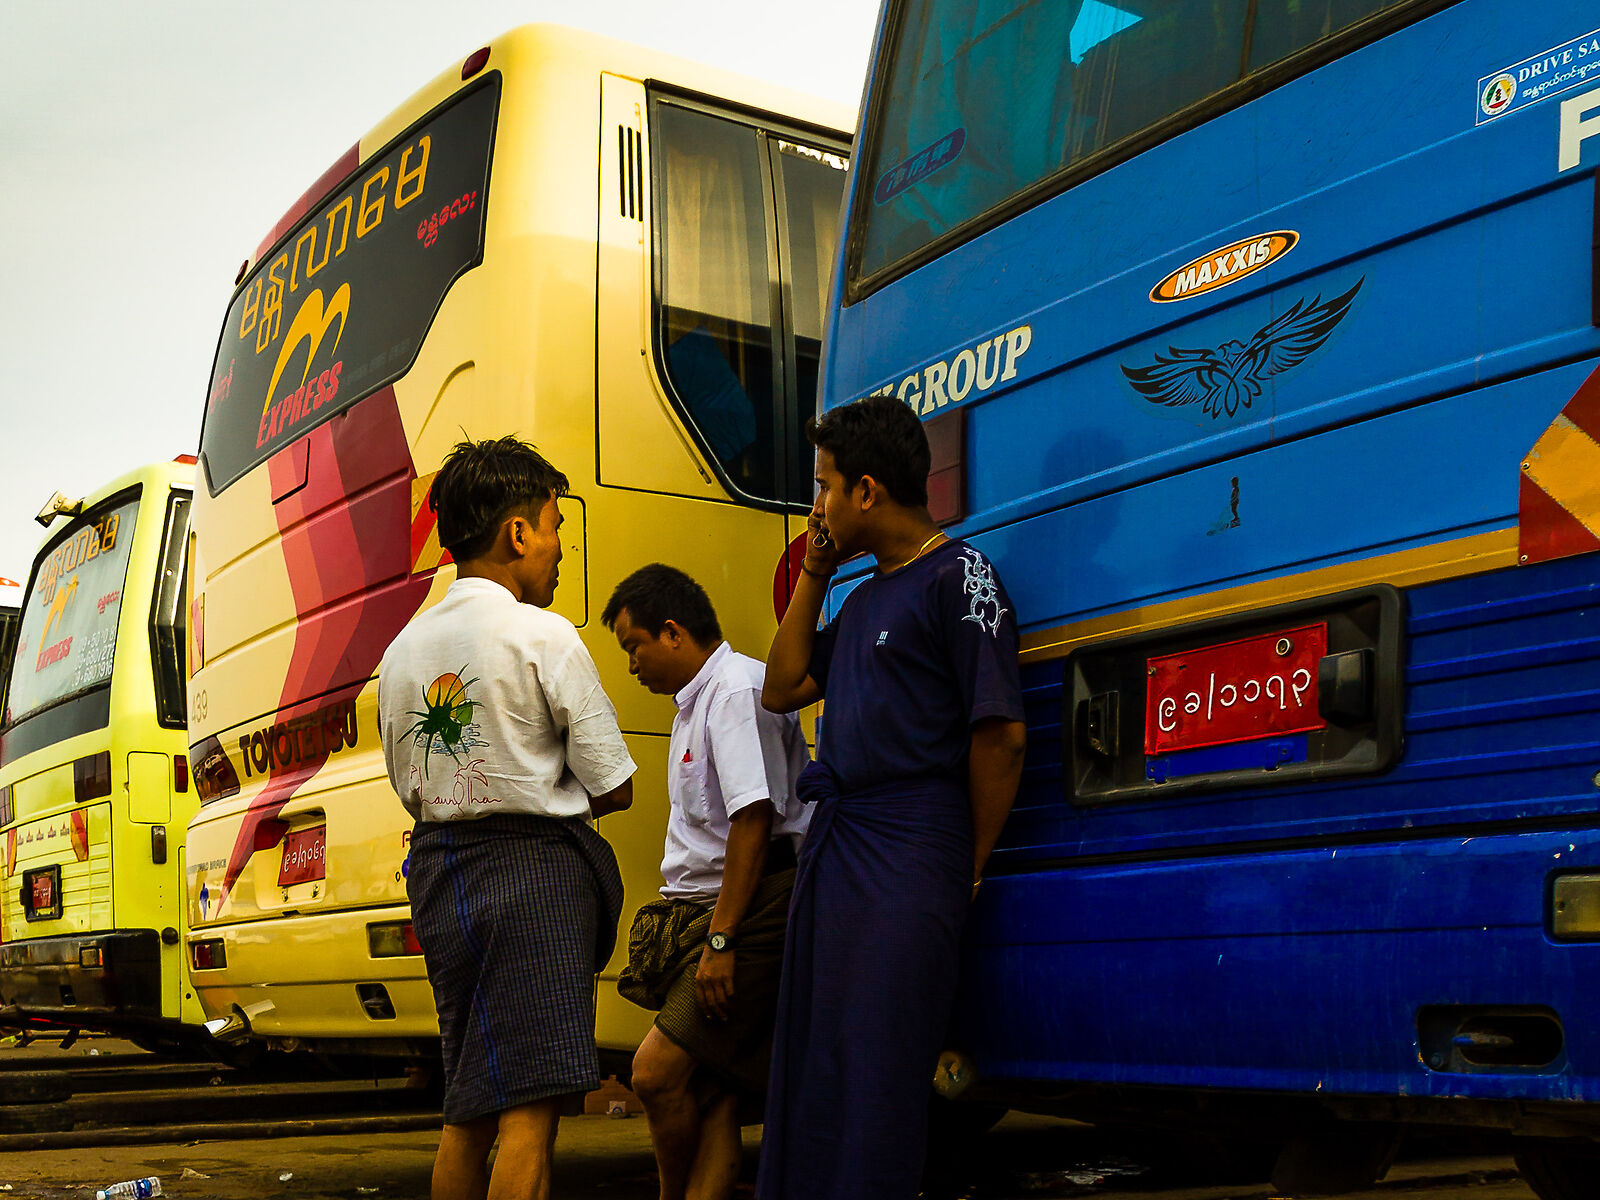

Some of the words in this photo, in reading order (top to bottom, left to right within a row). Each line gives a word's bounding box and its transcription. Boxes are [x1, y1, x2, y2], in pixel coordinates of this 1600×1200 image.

[1518, 49, 1574, 83] DRIVE
[1173, 237, 1271, 297] MAXXIS
[256, 360, 343, 449] EXPRESS
[897, 324, 1032, 416] GROUP
[36, 636, 73, 673] EXPRESS
[239, 698, 358, 777] TOYOTETSU
